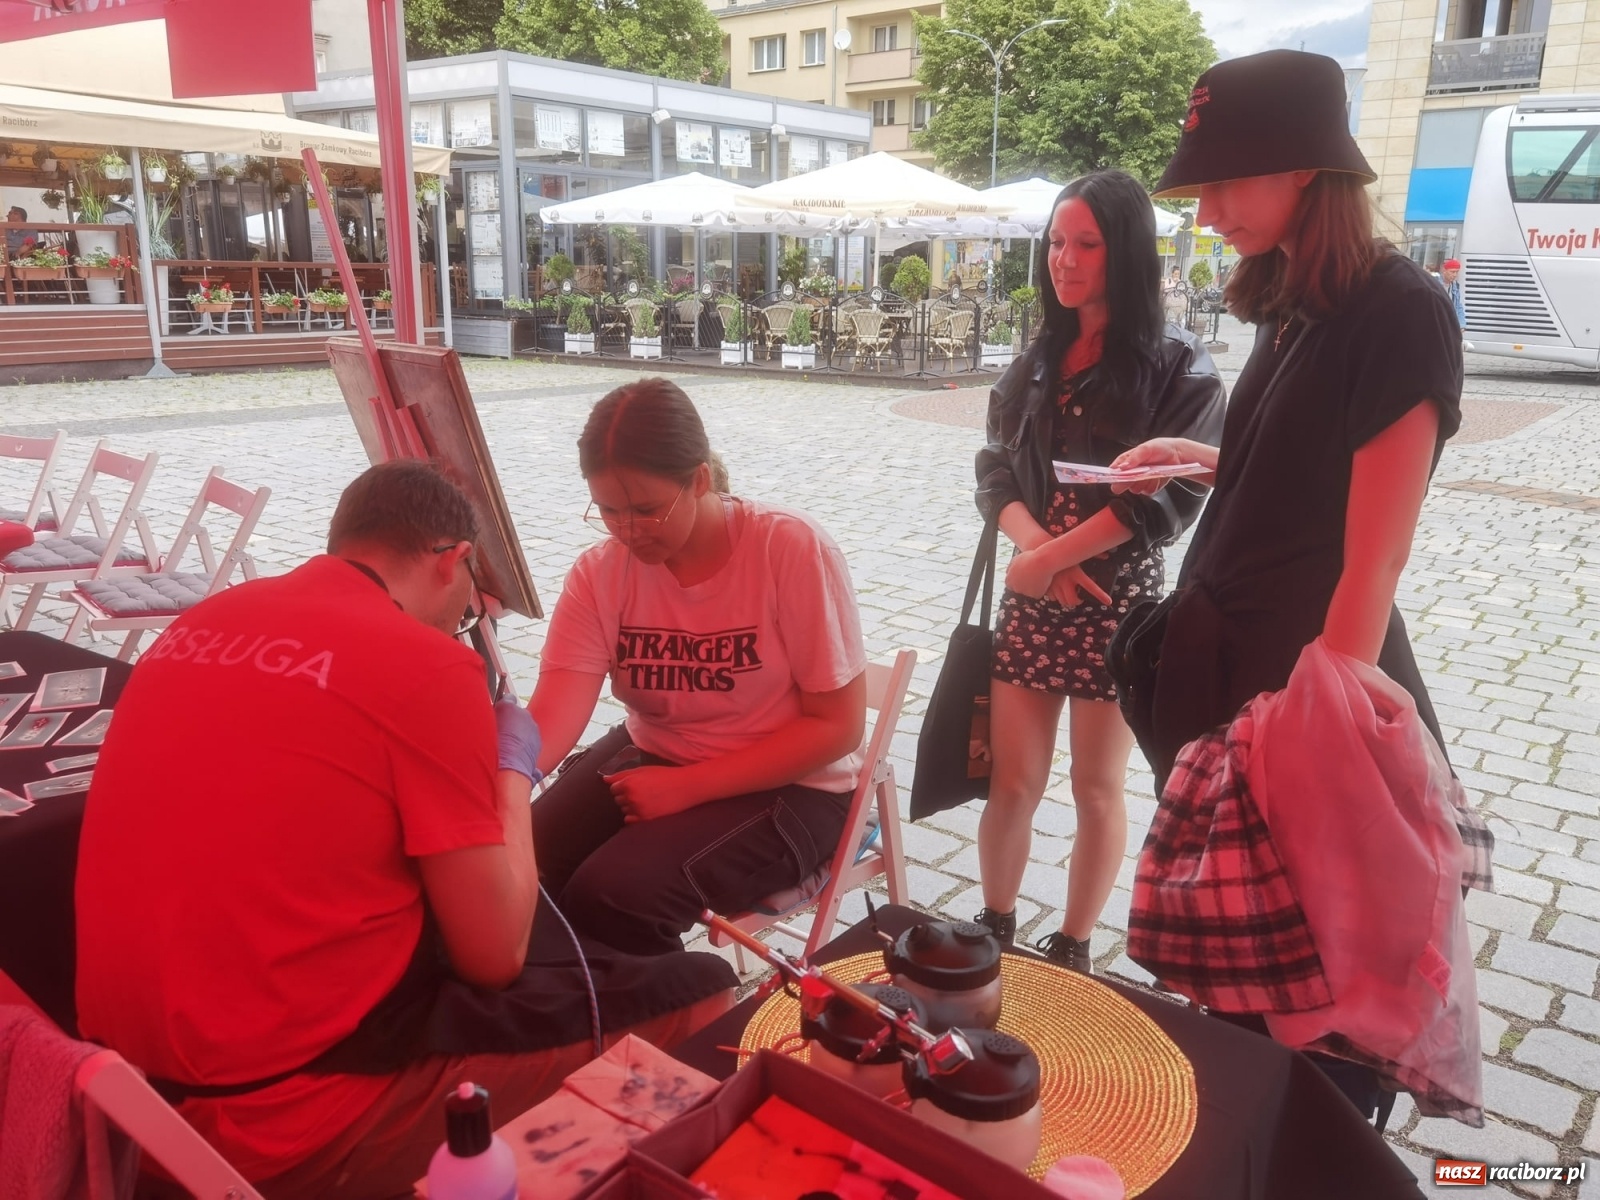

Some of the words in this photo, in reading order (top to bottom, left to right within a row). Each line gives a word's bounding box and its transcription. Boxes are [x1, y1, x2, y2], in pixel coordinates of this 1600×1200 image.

[2, 115, 38, 128] Racibórz
[321, 142, 347, 155] Zamkowy
[1527, 228, 1587, 255] Twoja
[616, 631, 763, 668] STRANGER
[627, 664, 736, 692] THINGS
